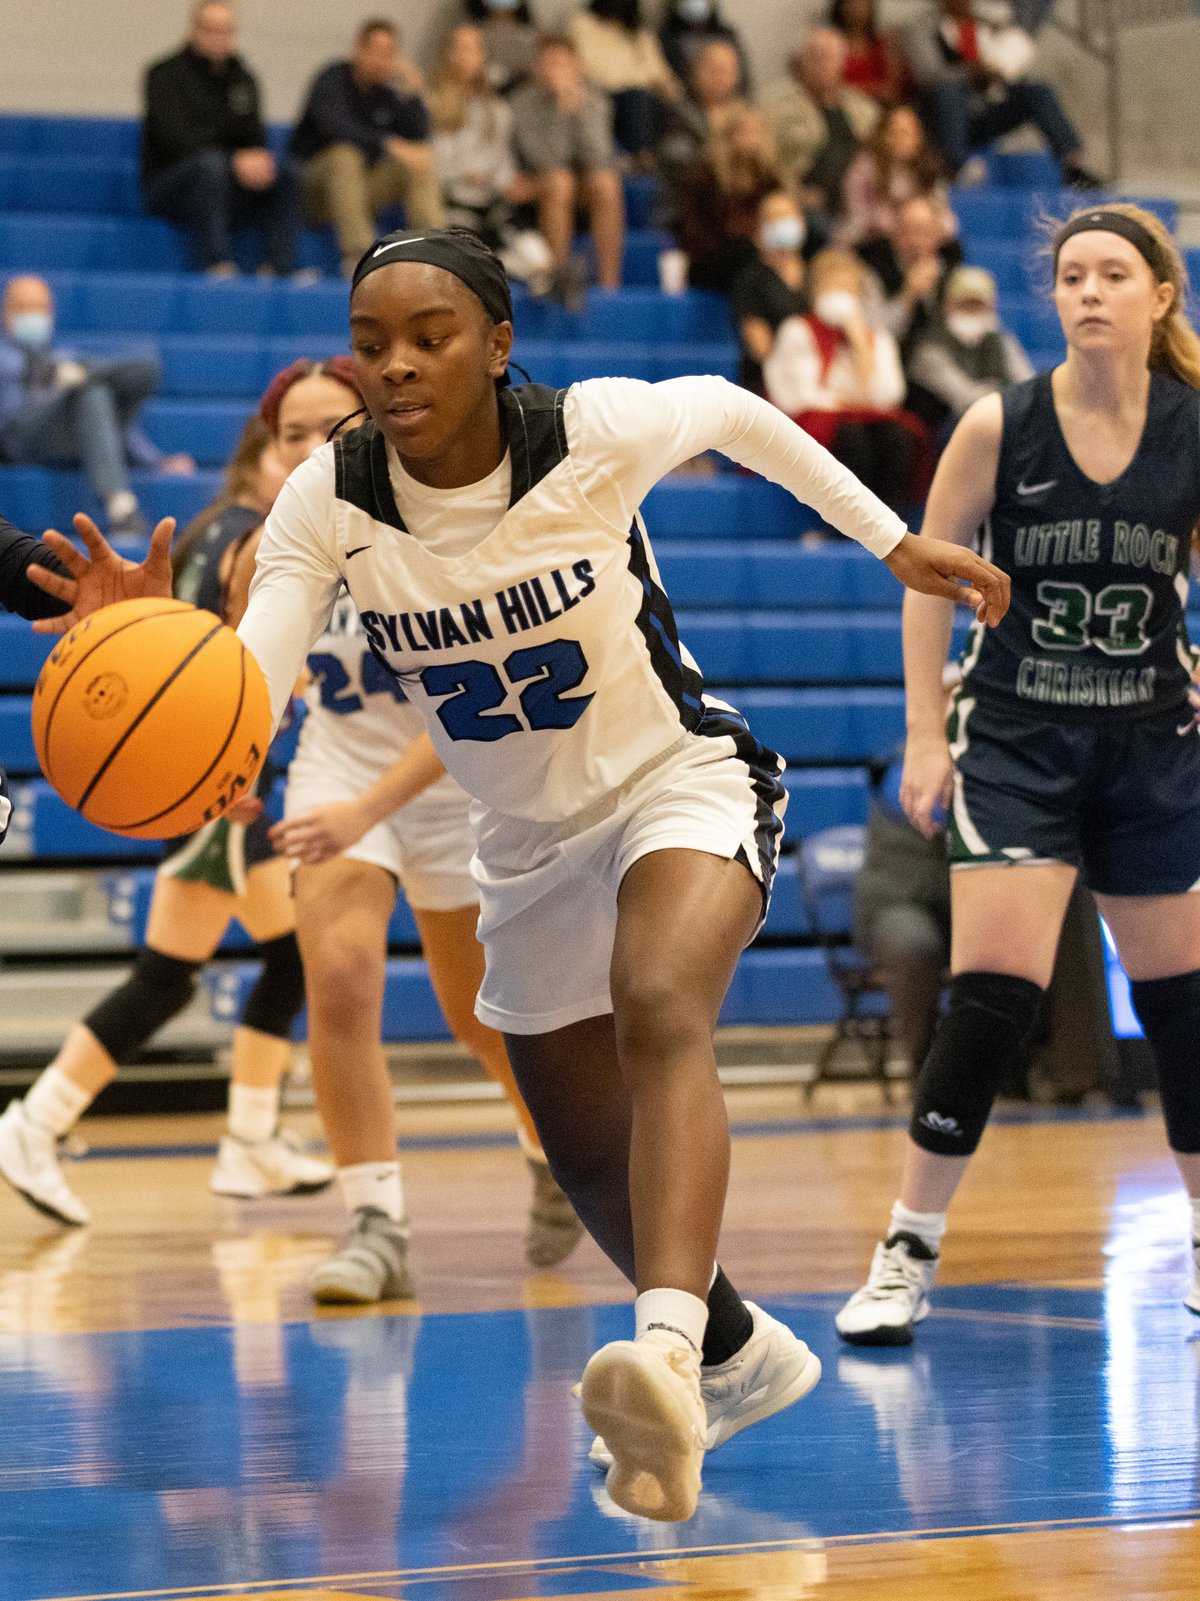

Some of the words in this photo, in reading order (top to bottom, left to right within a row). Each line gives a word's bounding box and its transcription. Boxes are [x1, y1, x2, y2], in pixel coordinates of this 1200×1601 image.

[1014, 518, 1101, 567] LITTLE
[1112, 519, 1180, 577] ROCK
[359, 600, 494, 652] SYLVAN
[495, 558, 596, 635] HILLS
[1031, 579, 1154, 656] 33
[418, 638, 597, 742] 22
[1016, 656, 1157, 707] CHRISTIAN
